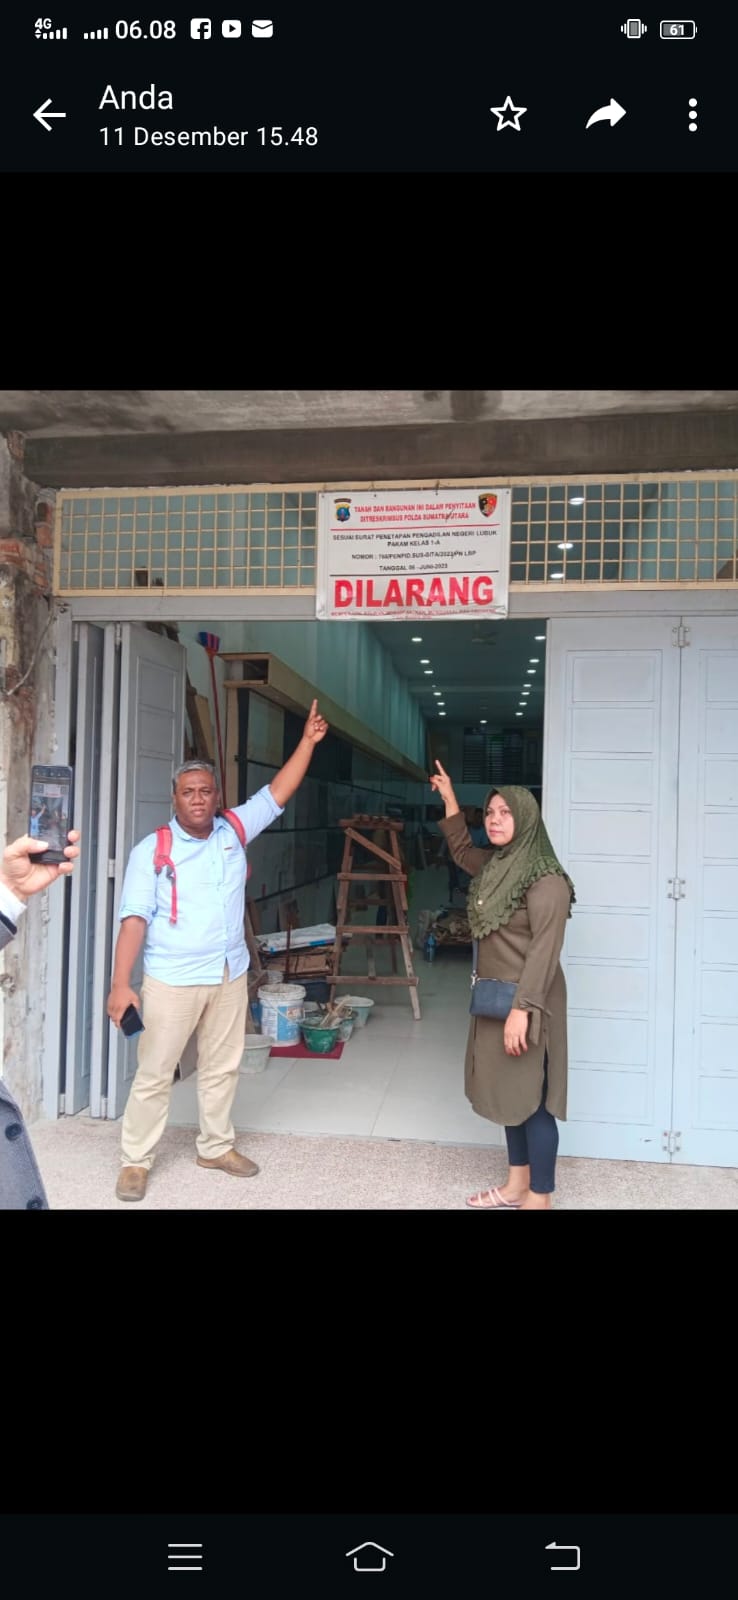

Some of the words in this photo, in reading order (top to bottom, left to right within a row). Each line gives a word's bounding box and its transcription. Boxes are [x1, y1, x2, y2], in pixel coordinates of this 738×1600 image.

[385, 504, 416, 512] BANGUNAN
[425, 503, 444, 511] DALAM
[445, 502, 476, 510] PENYITAAN
[360, 514, 403, 523] DITRESKRIMSUS
[334, 575, 494, 608] DILARANG
